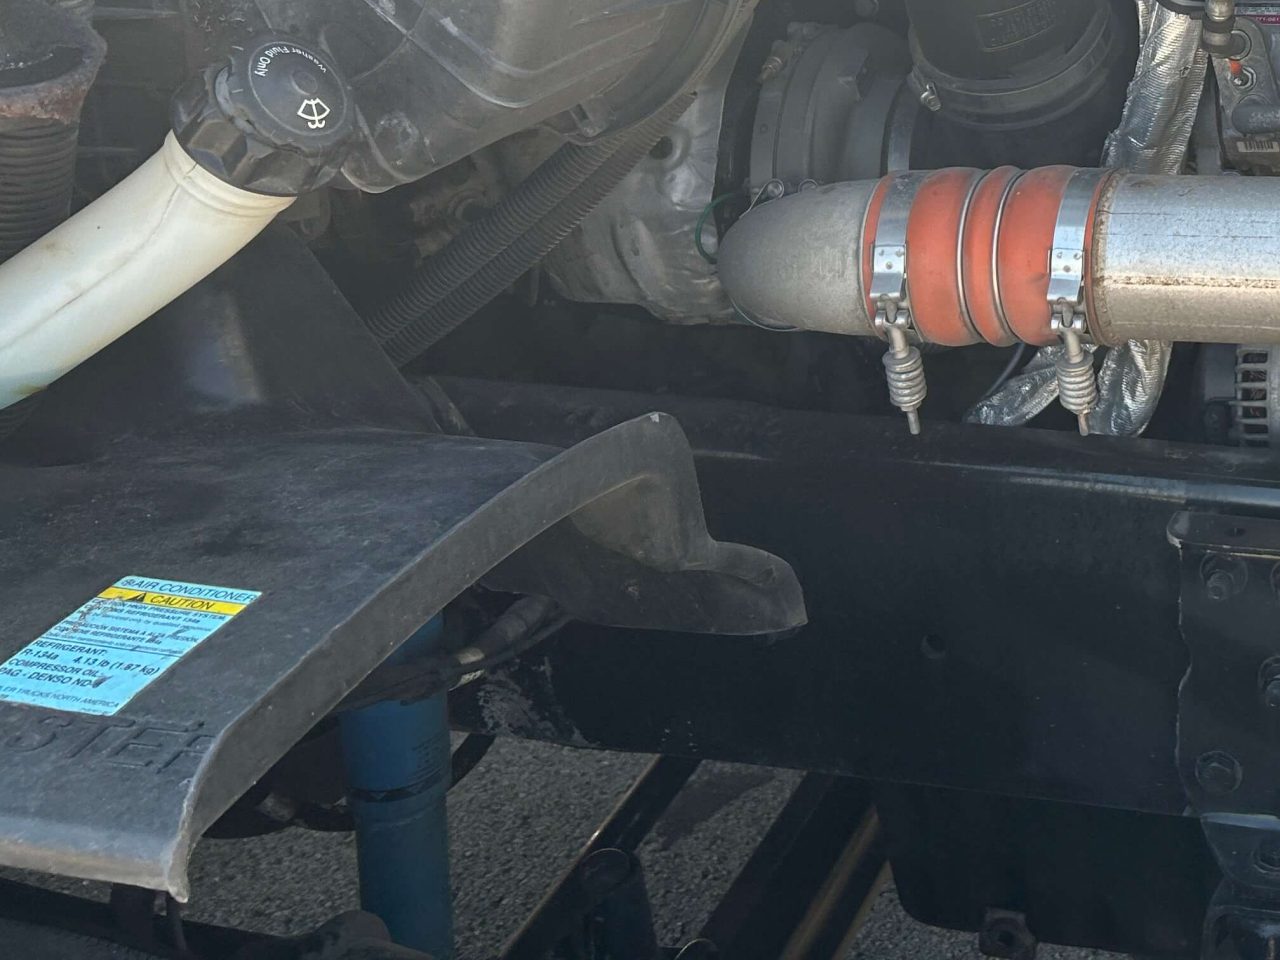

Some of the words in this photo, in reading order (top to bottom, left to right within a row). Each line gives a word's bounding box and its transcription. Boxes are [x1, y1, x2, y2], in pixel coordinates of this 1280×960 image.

[264, 46, 290, 57] Fluid
[291, 47, 327, 73] Washer
[254, 56, 271, 77] Only
[131, 579, 158, 590] AIR
[160, 583, 256, 602] CONDITIONER
[150, 595, 214, 610] CAUTION
[8, 658, 81, 675] COMPRESSOR
[21, 648, 59, 660] R-134a
[73, 656, 98, 666] 4.13
[99, 659, 110, 667] lb
[139, 665, 160, 676] kg)
[28, 671, 72, 685] DENSO
[50, 691, 82, 703] NORTH
[82, 697, 120, 709] AMERICA
